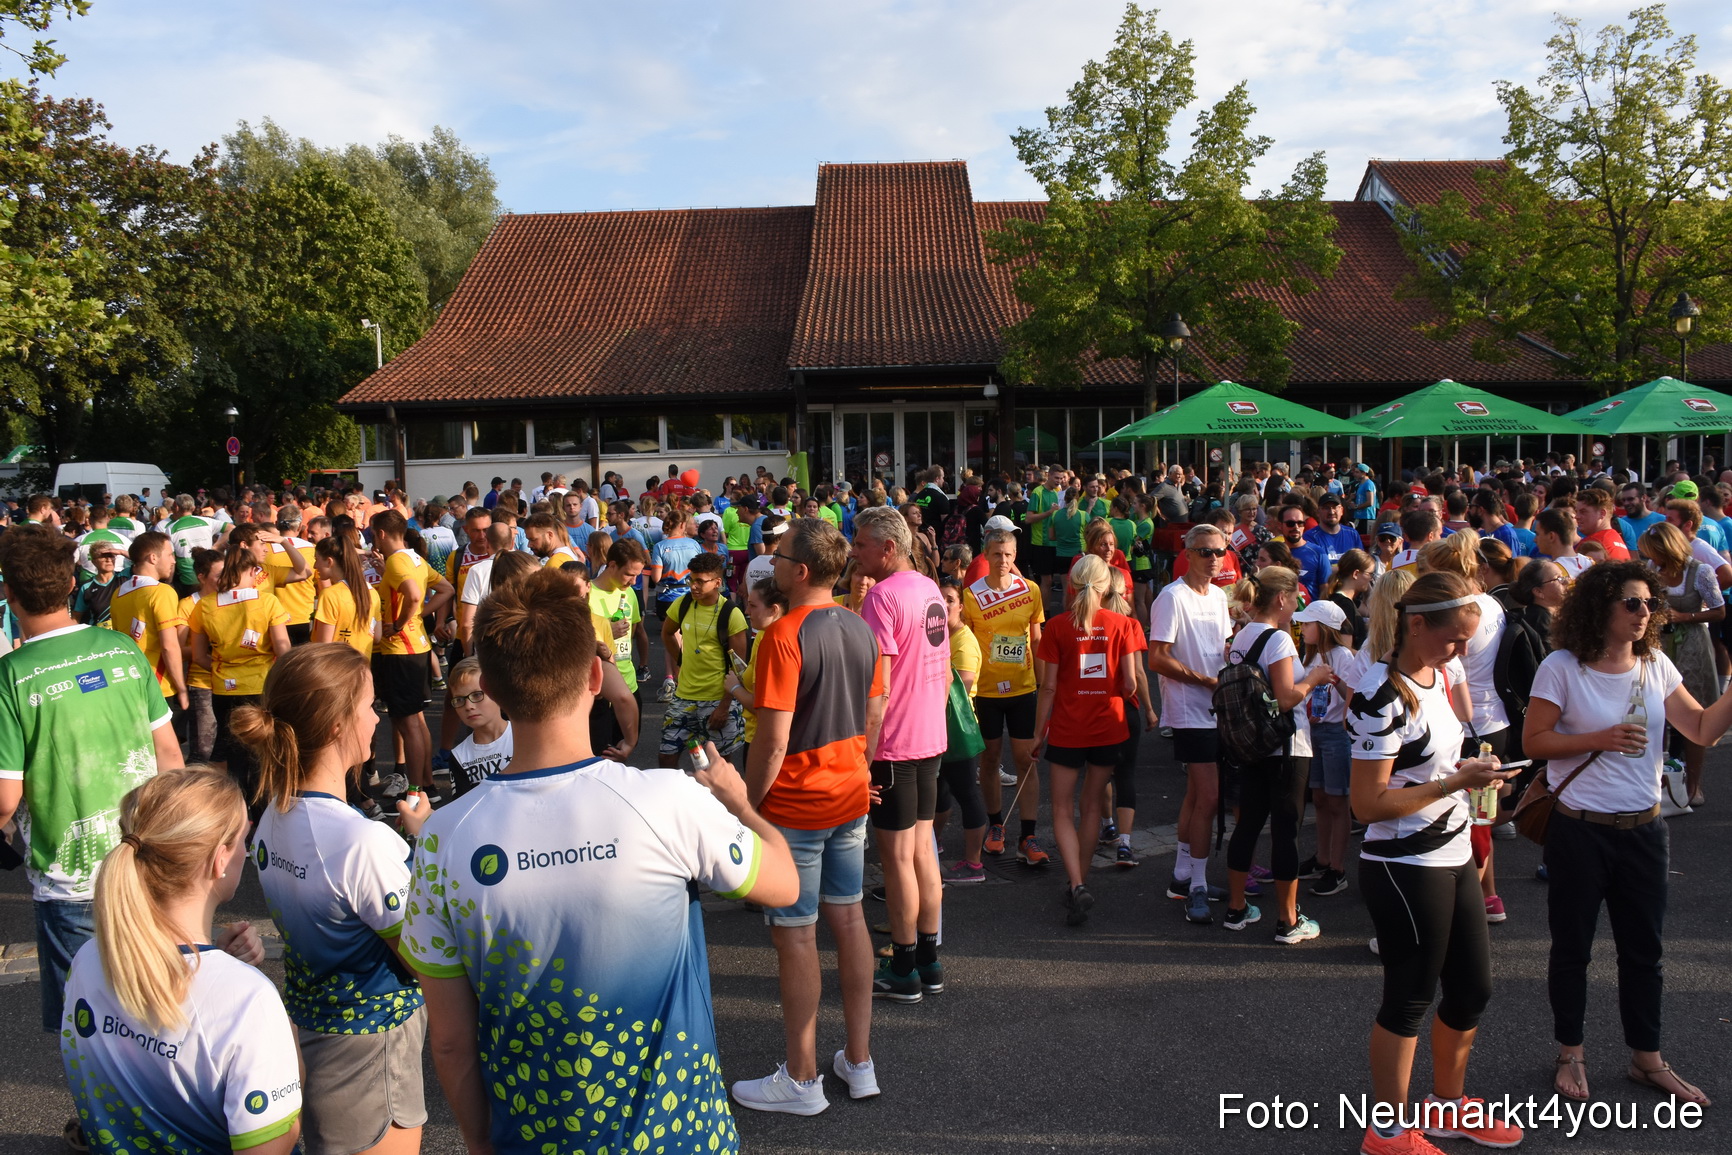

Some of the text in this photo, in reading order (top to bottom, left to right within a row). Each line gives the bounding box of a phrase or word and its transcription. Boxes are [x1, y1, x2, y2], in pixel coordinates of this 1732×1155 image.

[1216, 416, 1287, 424] Neumarkter
[1450, 417, 1519, 426] Neumarkter
[1206, 422, 1305, 430] Lammsbräu
[1442, 424, 1539, 432] Lammsbräu
[1674, 421, 1731, 429] Lamms
[983, 596, 1034, 620] MAX BÖGL
[997, 644, 1023, 656] 1646
